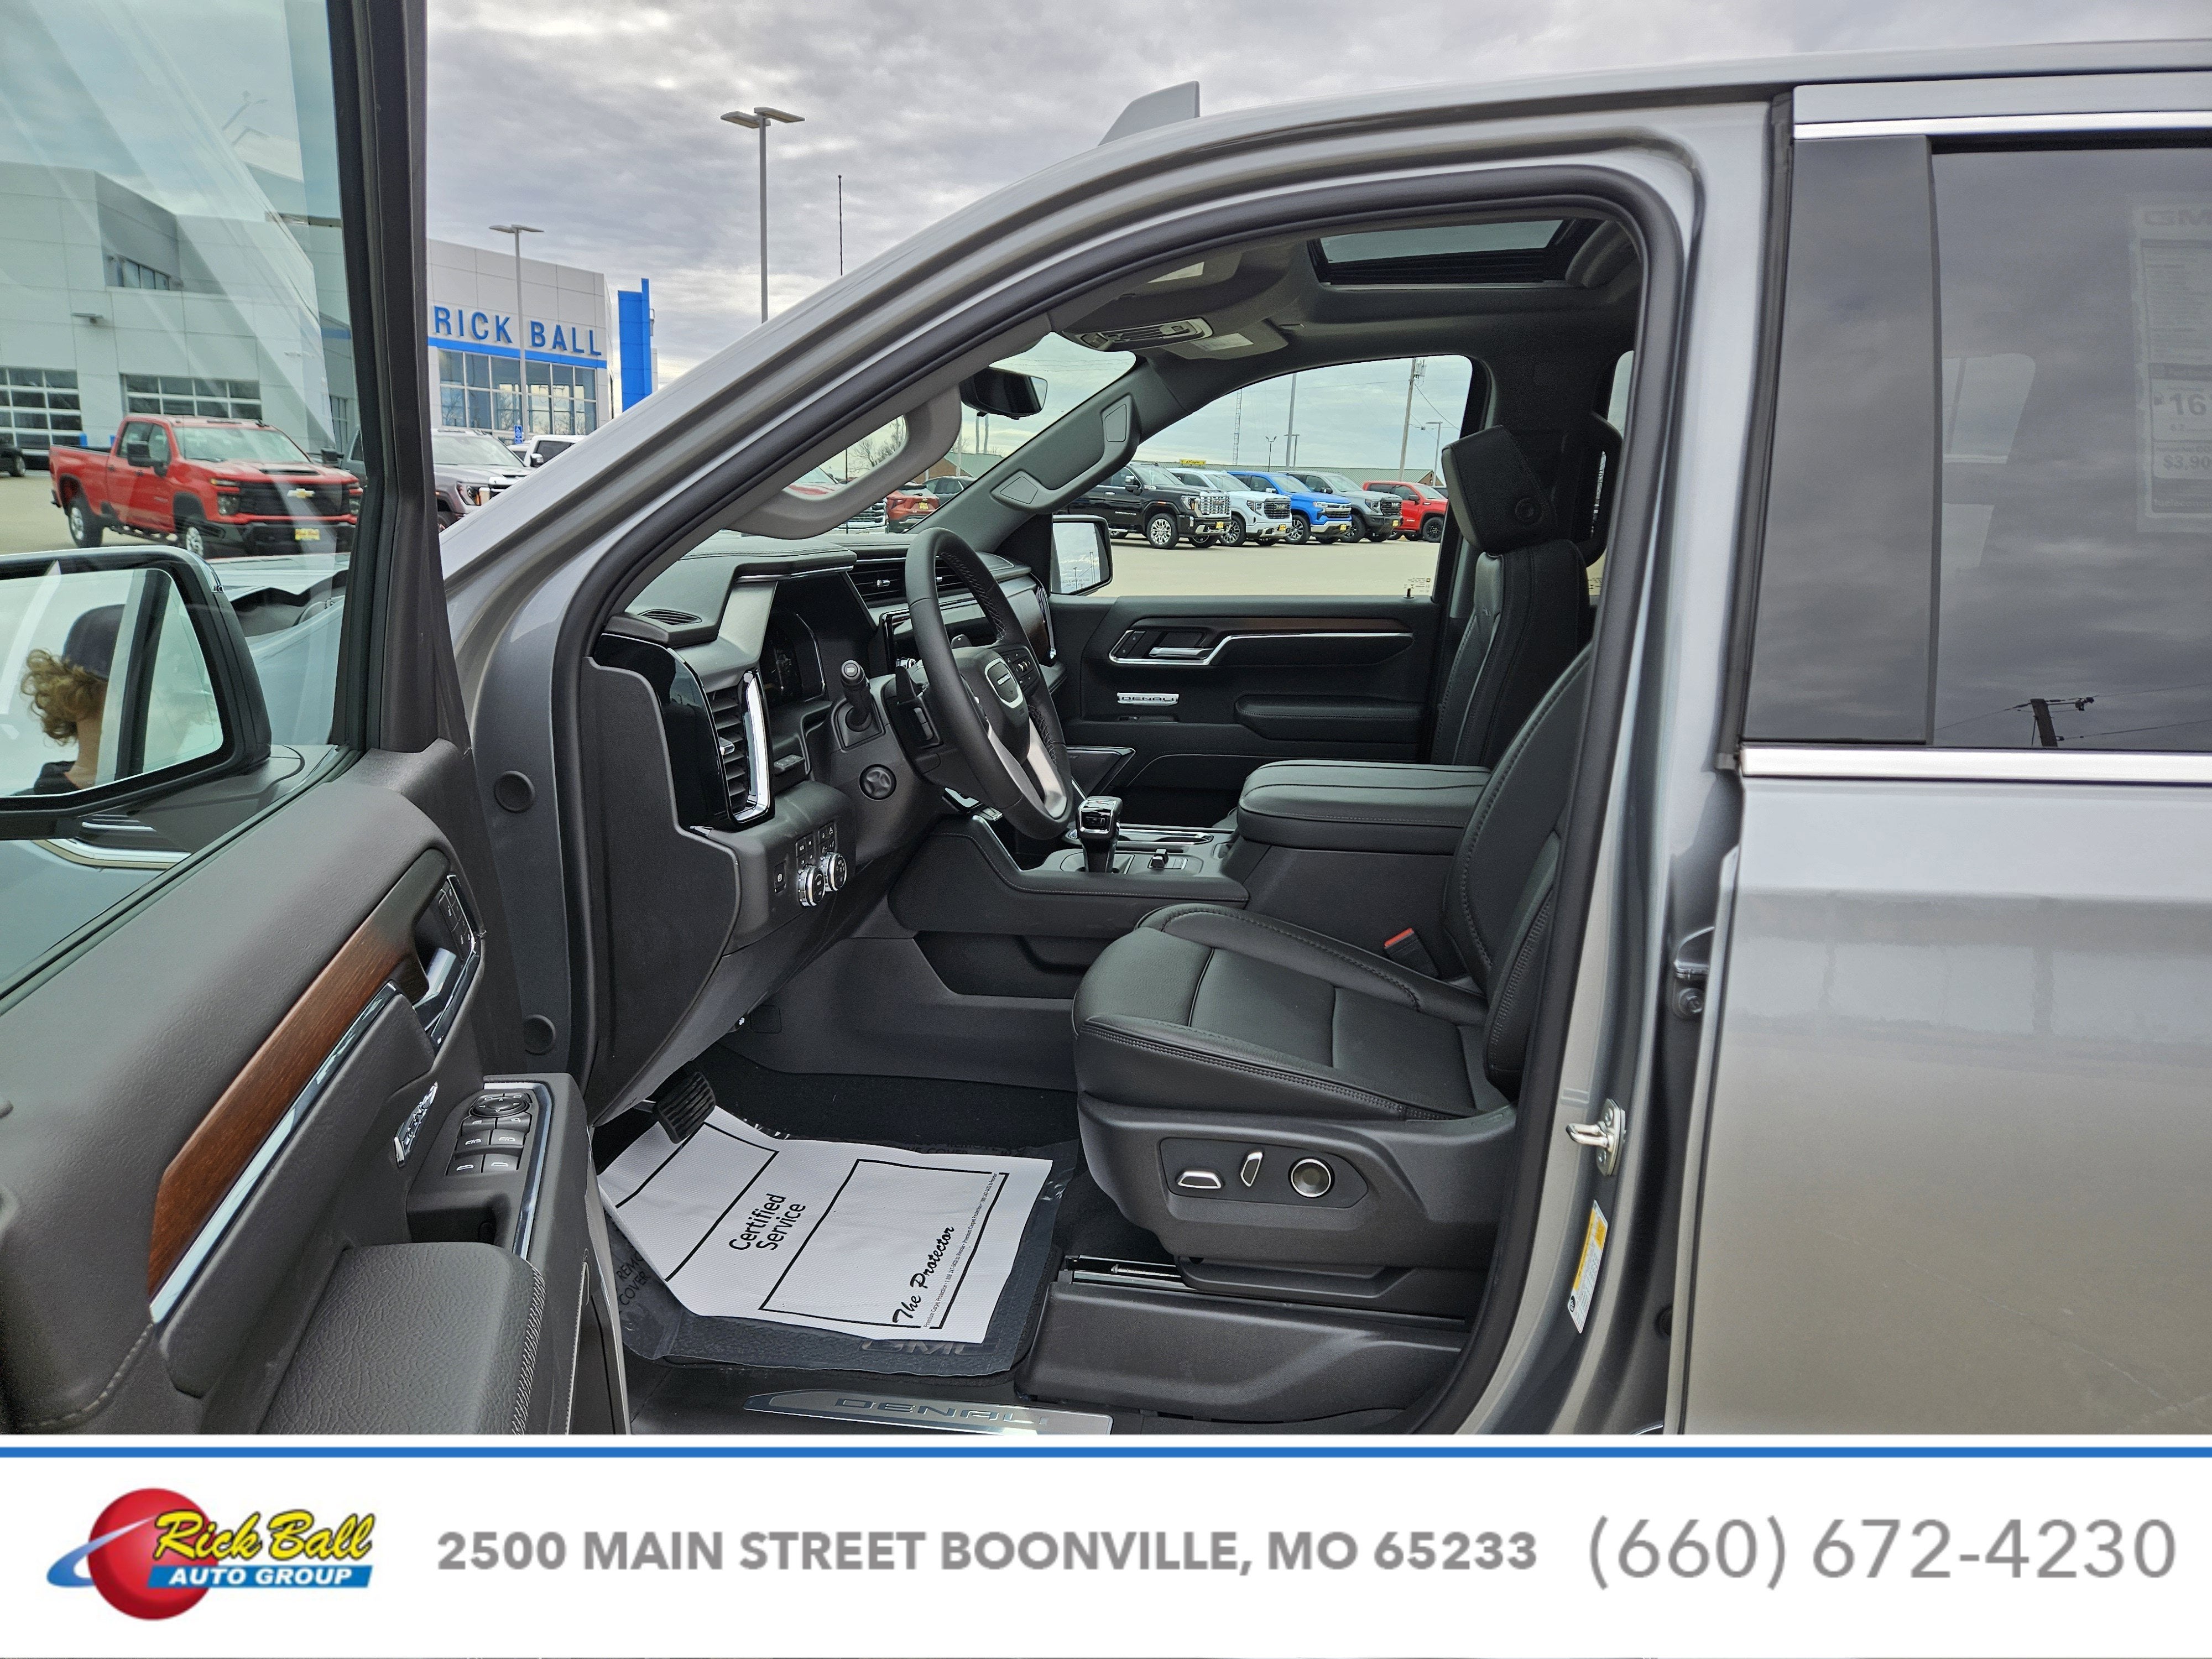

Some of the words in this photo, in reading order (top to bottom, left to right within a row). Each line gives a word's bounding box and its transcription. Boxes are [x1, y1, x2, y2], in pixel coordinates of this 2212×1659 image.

[434, 306, 513, 343] RICK
[530, 320, 602, 356] BALL
[729, 1193, 786, 1250] Certified
[755, 1204, 806, 1251] Service
[619, 1271, 651, 1305] COVER
[892, 1295, 922, 1323] The
[910, 1227, 954, 1289] Protector
[835, 1398, 1050, 1425] DENALI
